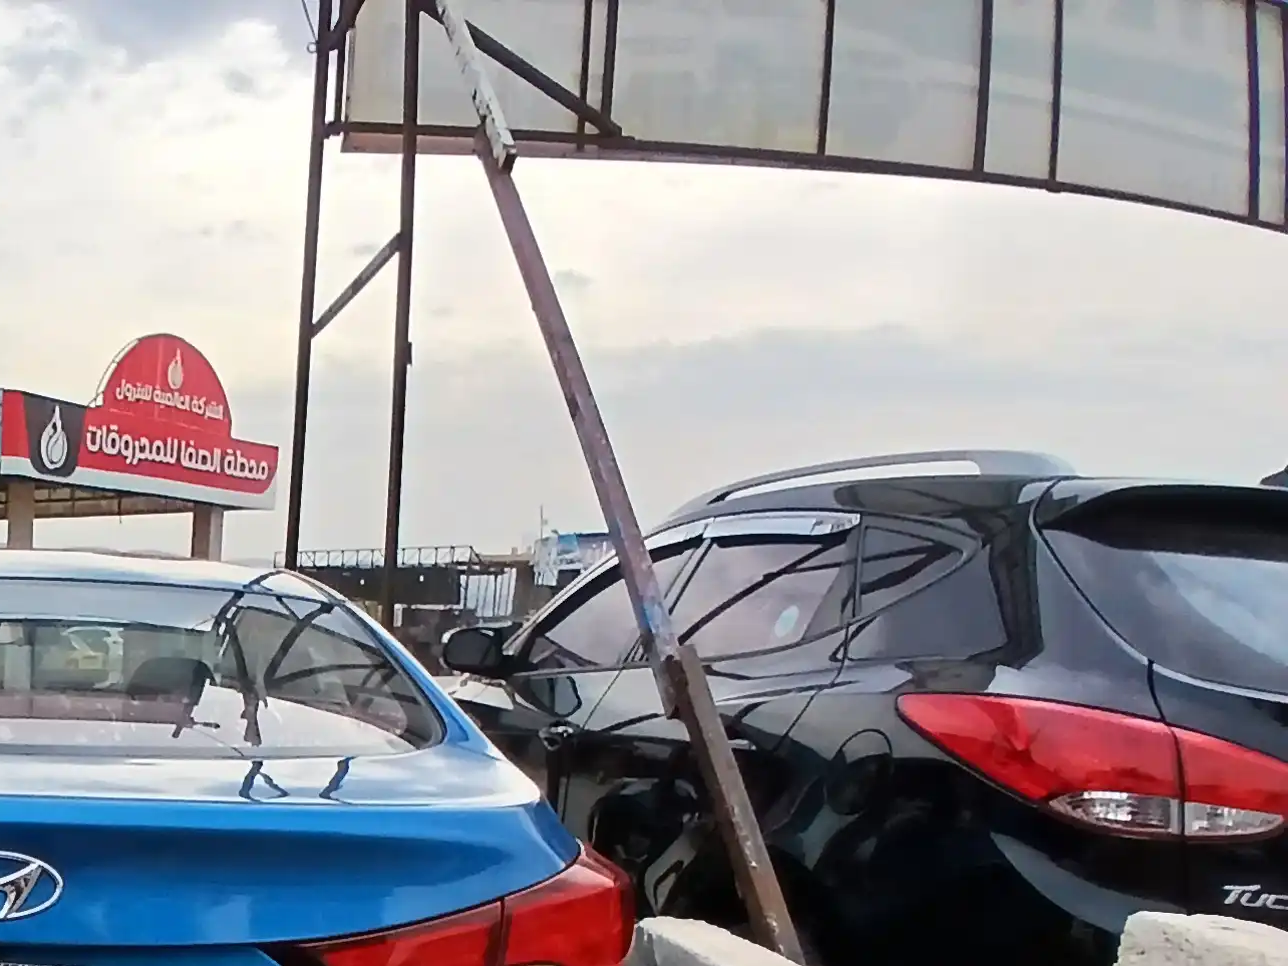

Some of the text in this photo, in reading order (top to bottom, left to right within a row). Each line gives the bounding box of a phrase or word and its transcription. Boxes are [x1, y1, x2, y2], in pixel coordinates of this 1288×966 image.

[86, 424, 269, 480] محطة الصفا للمحروقات
